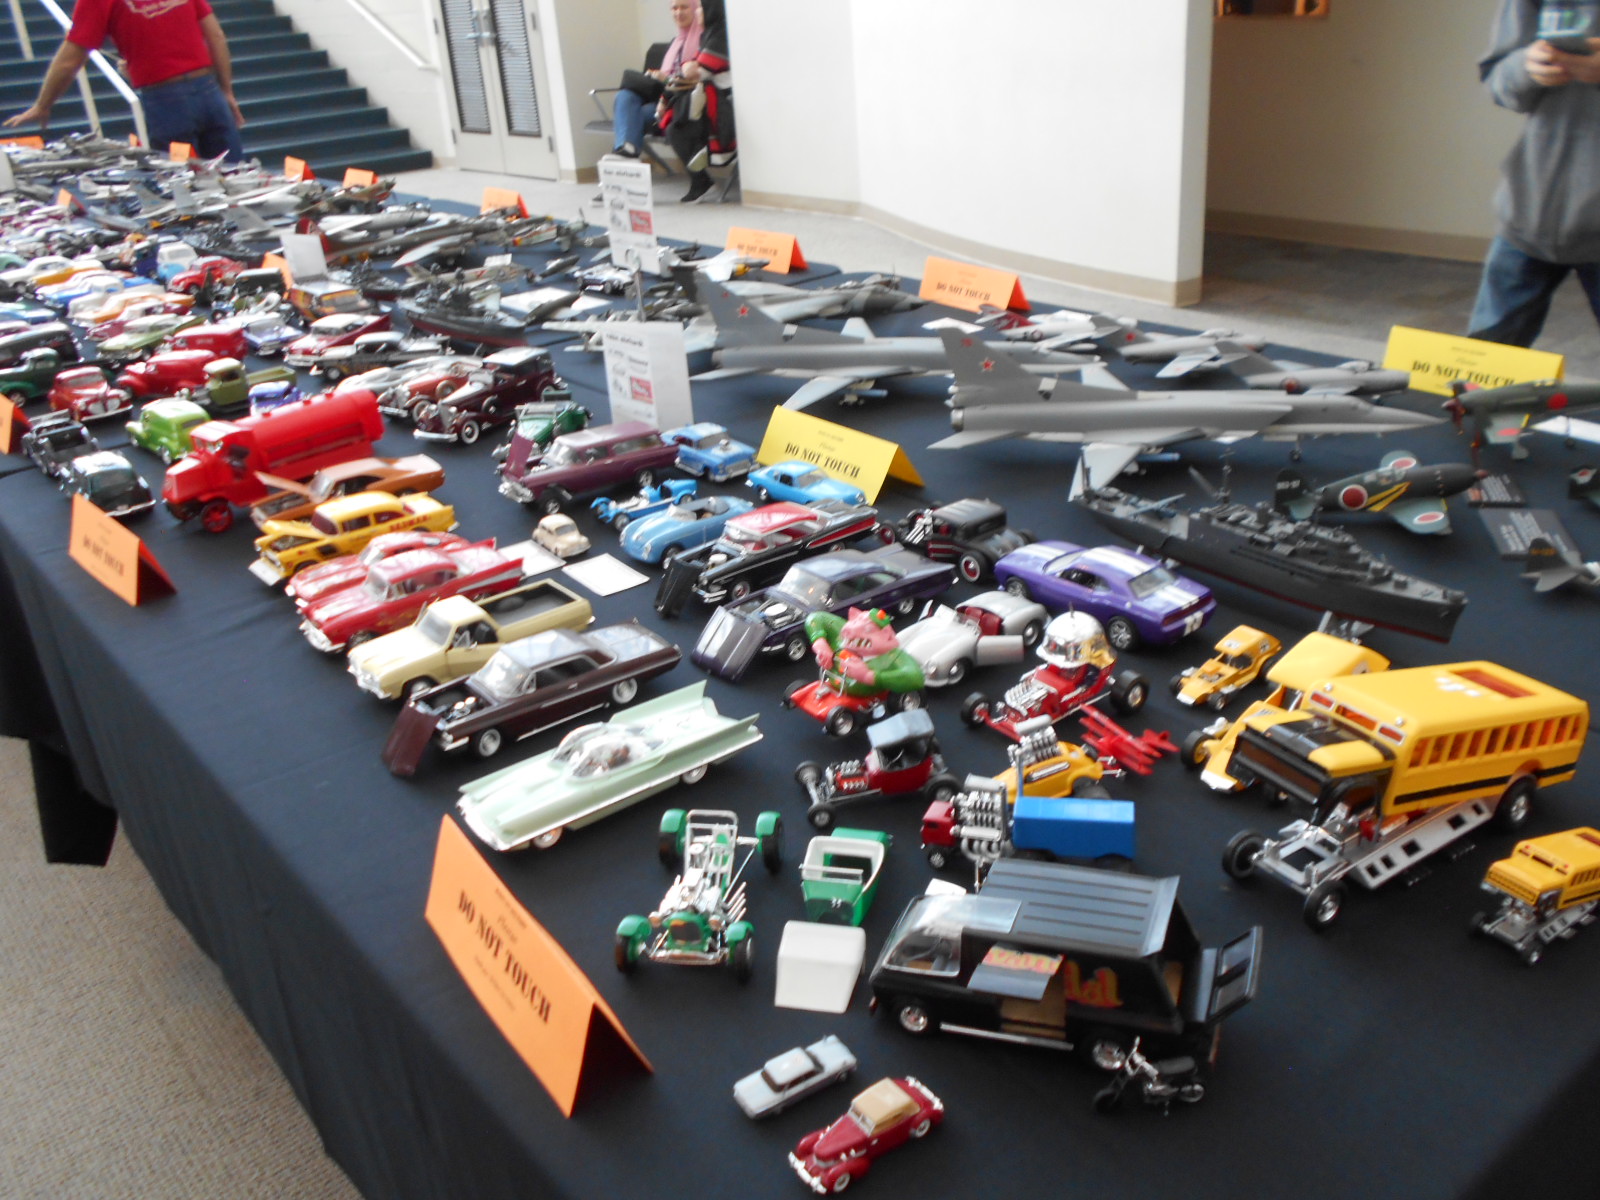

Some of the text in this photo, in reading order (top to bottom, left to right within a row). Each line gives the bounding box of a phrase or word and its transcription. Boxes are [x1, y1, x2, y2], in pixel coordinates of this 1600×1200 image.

[936, 282, 991, 301] DO NOT TOUCH
[1411, 360, 1515, 386] DO NOT TOUCH
[784, 442, 861, 479] DO NOT TOUCH
[458, 889, 475, 923] DO
[476, 913, 502, 958] NOT
[504, 949, 551, 1024] TOUCH
